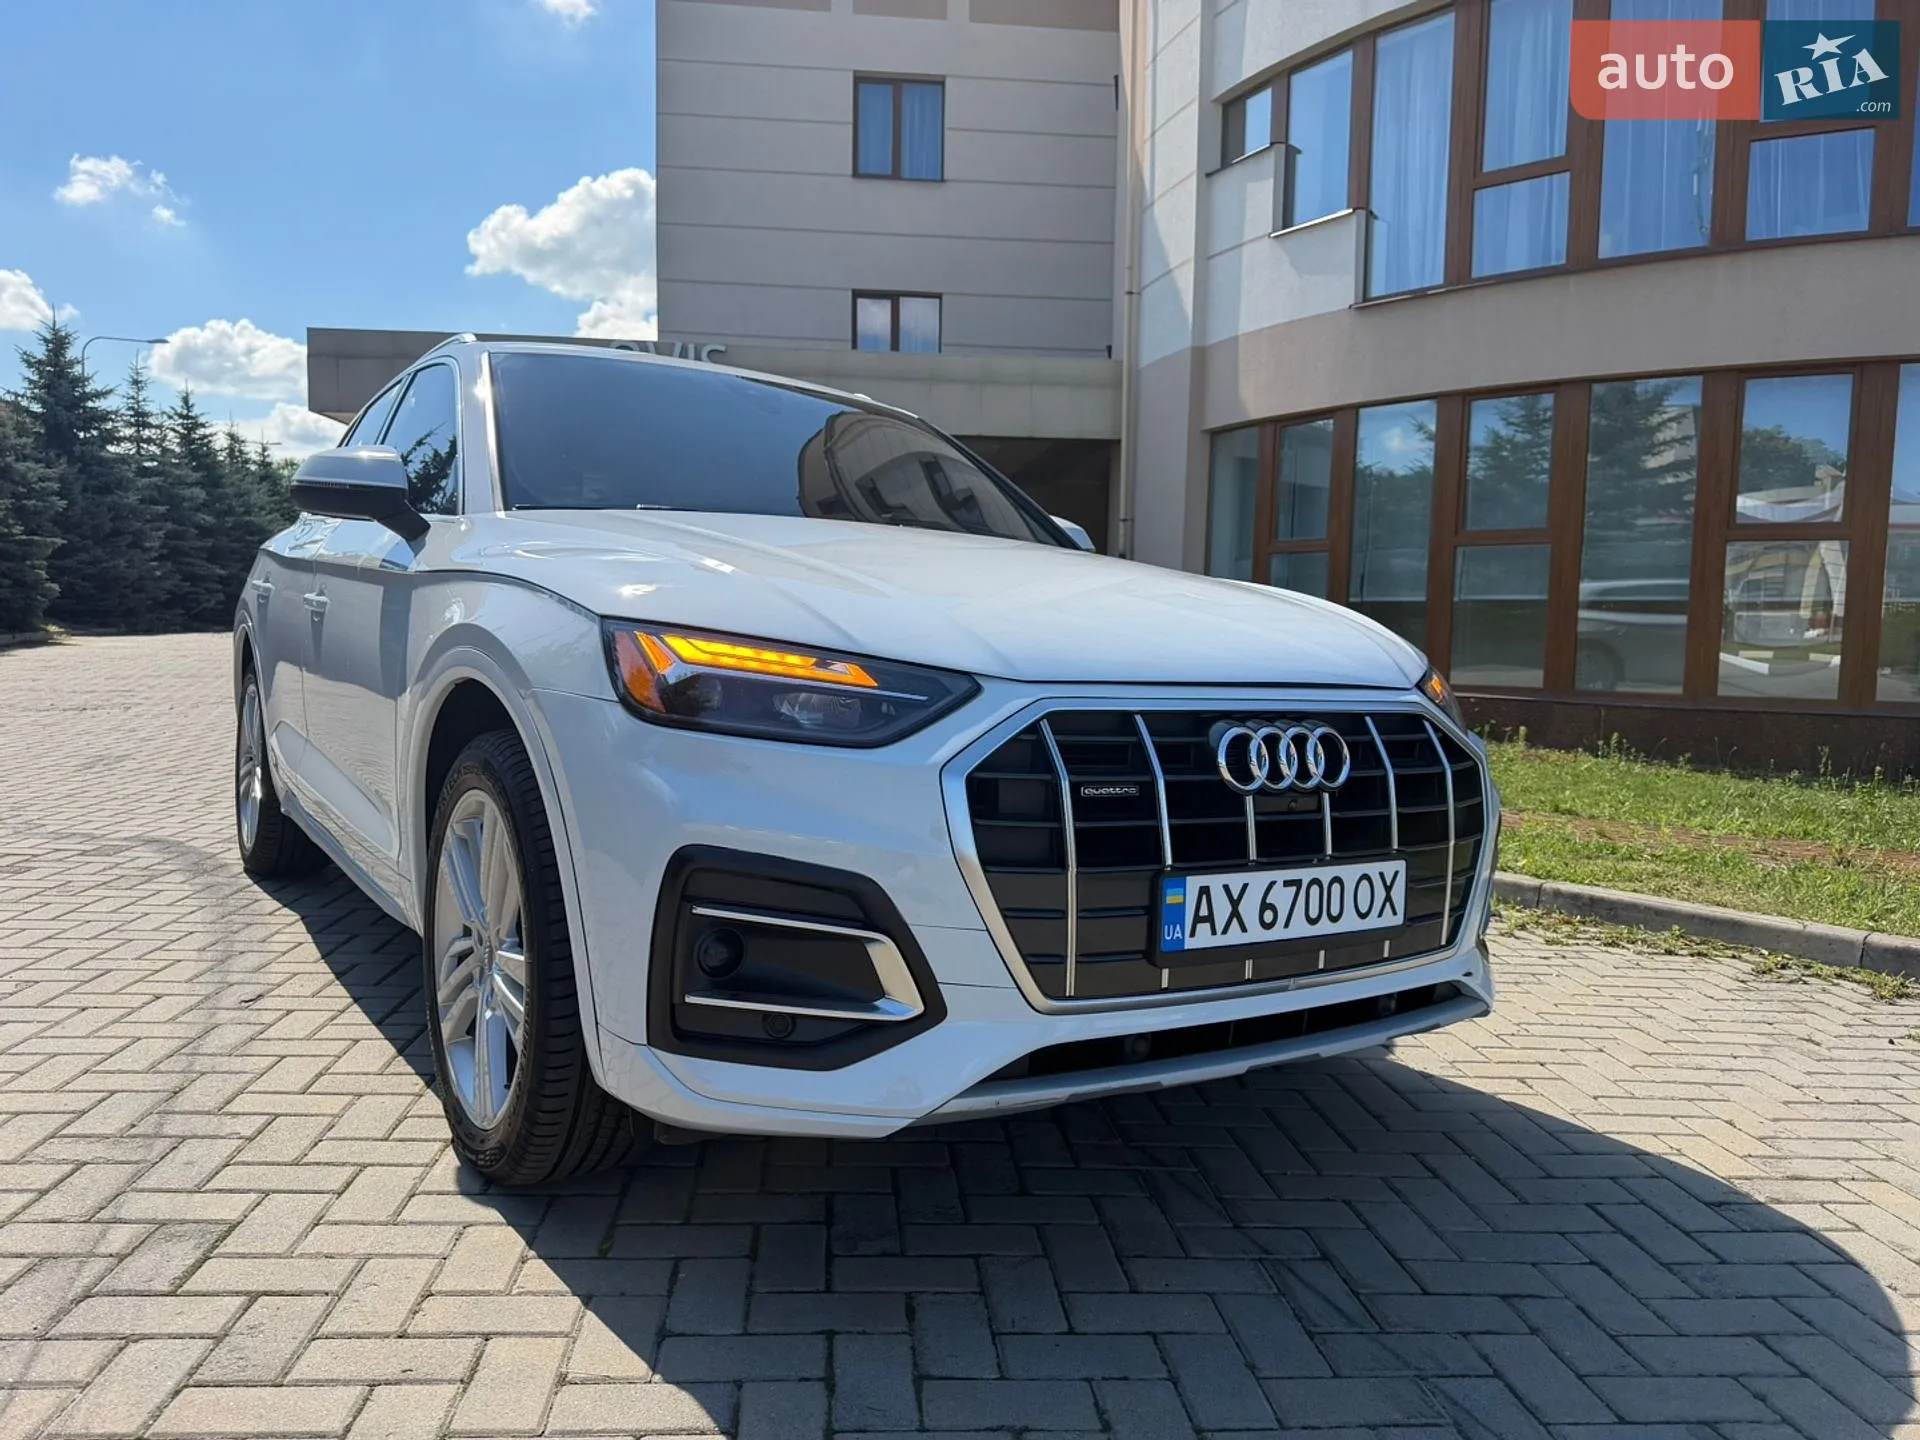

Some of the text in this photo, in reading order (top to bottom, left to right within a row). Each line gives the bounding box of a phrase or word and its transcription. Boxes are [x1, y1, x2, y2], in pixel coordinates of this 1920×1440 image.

[1083, 786, 1137, 796] quattro
[1189, 870, 1399, 937] AX 6700 OX
[1164, 925, 1183, 940] UA
